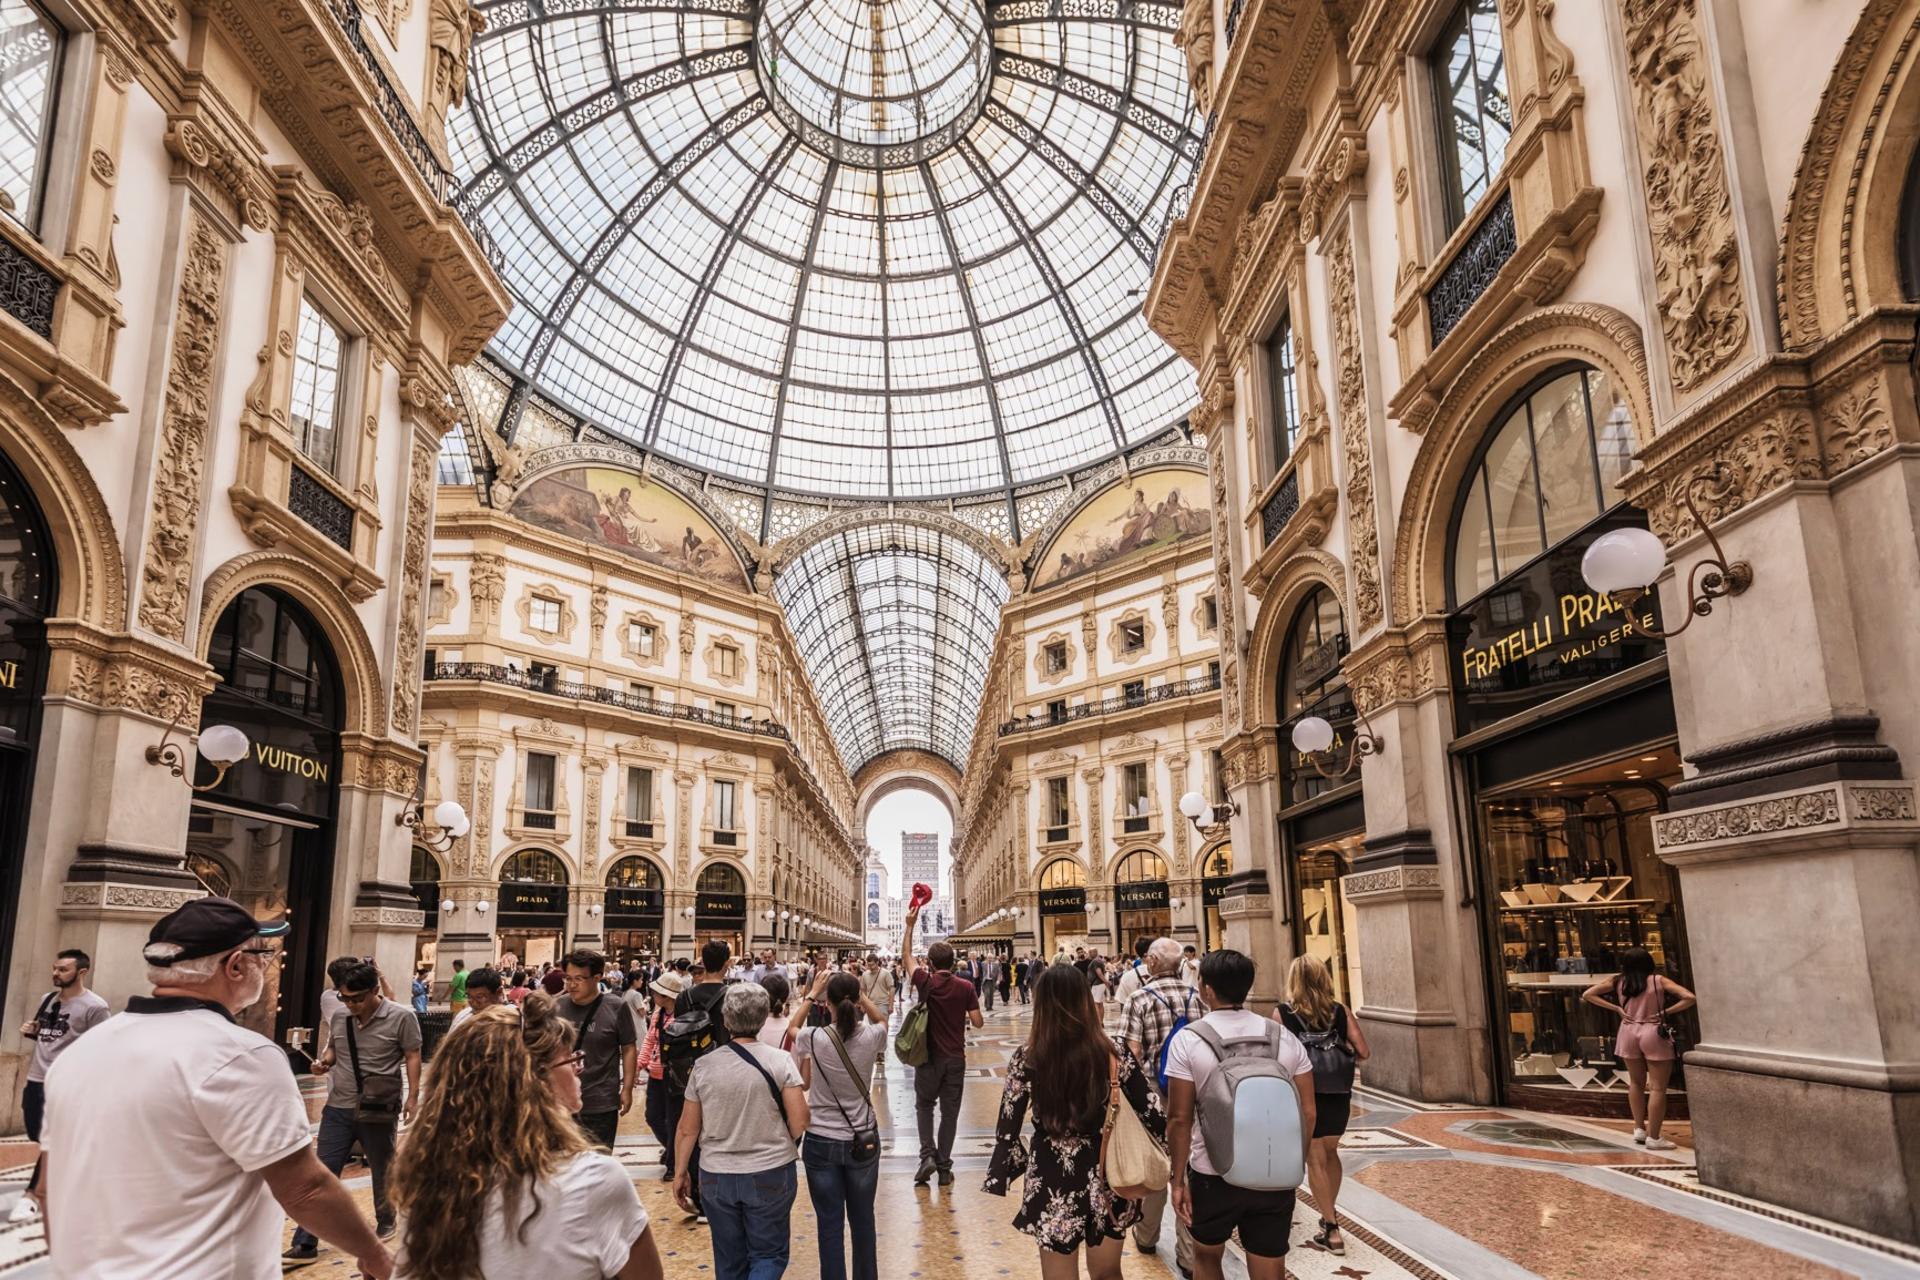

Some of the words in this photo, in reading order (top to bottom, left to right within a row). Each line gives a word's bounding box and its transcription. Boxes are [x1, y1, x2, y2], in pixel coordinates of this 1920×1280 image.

[1462, 615, 1552, 685] FRATELLI
[1561, 588, 1651, 636] PRA
[1560, 613, 1654, 664] VALIGERE
[256, 742, 327, 783] VUITTON
[516, 895, 549, 904] PRADA
[1043, 897, 1080, 906] VERSACE
[1120, 891, 1164, 902] VERSACE
